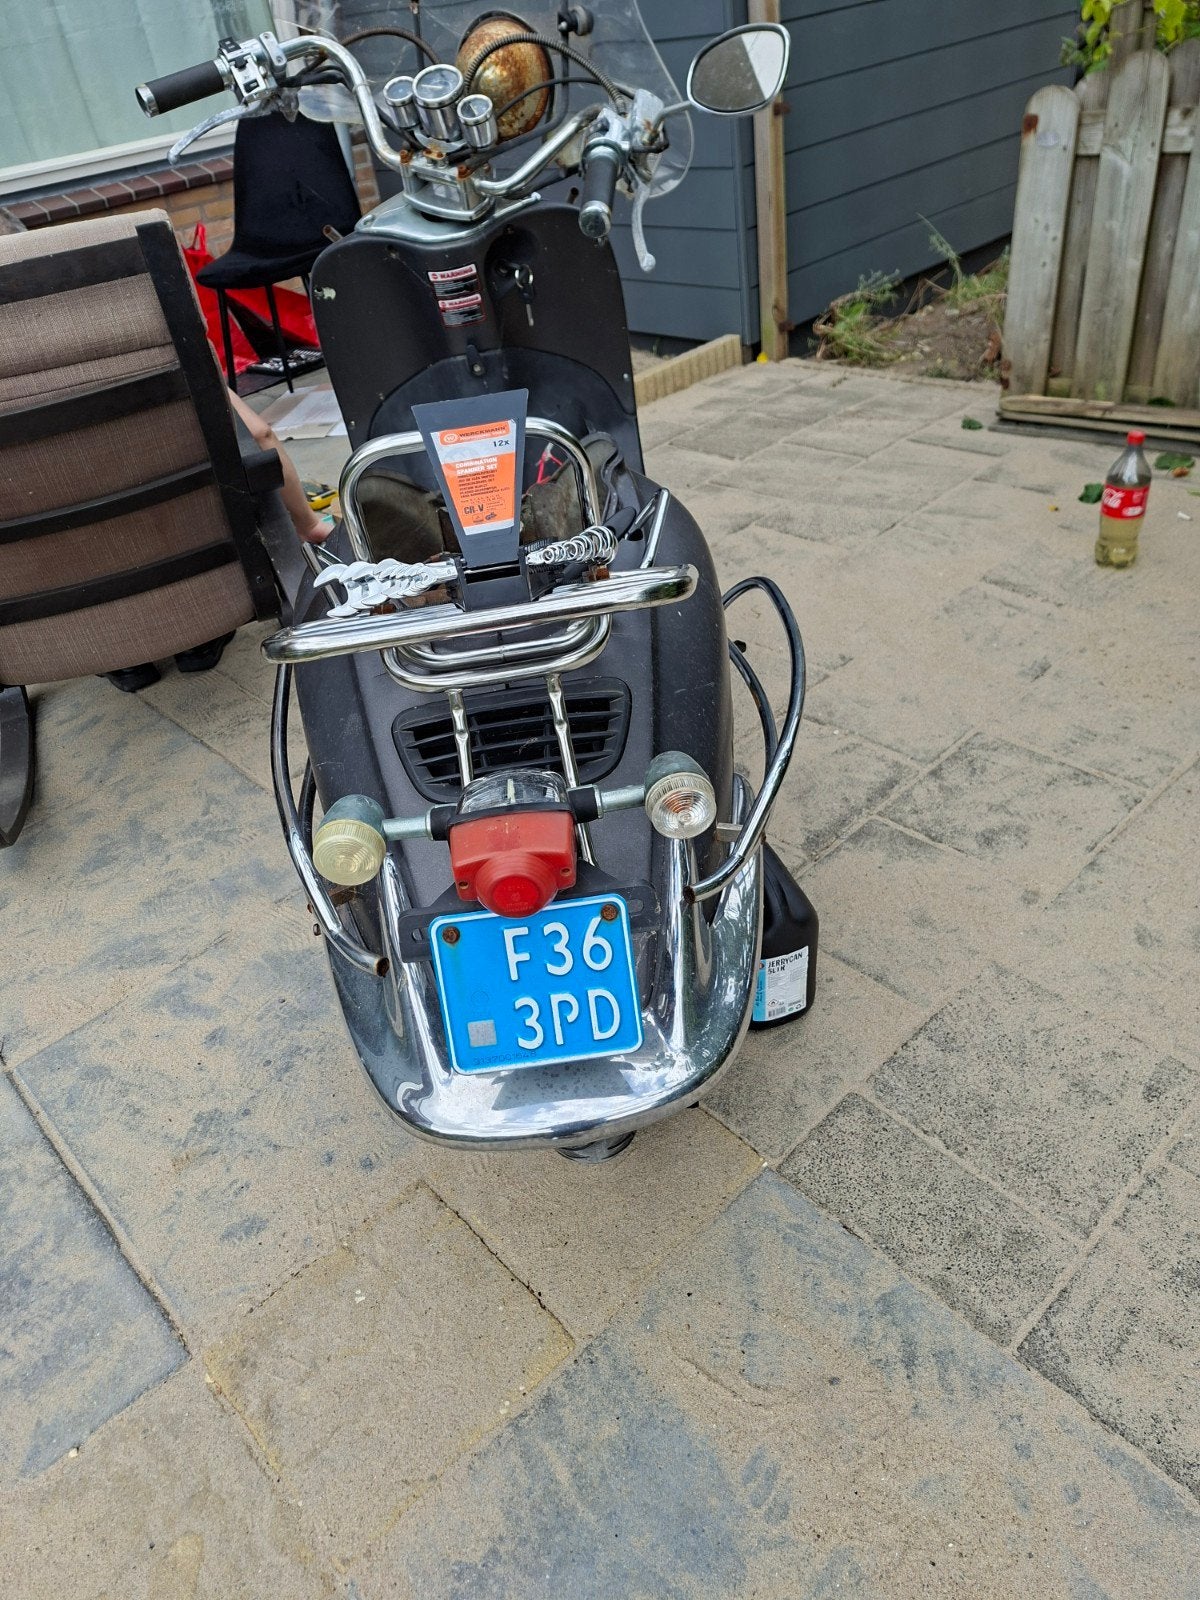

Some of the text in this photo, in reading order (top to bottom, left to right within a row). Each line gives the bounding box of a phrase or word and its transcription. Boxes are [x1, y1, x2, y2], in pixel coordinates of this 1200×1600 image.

[440, 267, 473, 279] WARNING
[459, 426, 506, 438] WERCKMANN
[493, 439, 510, 448] 12x
[455, 457, 498, 469] COMBINATION
[768, 952, 803, 968] JERRYCAN
[514, 988, 621, 1050] 3PD
